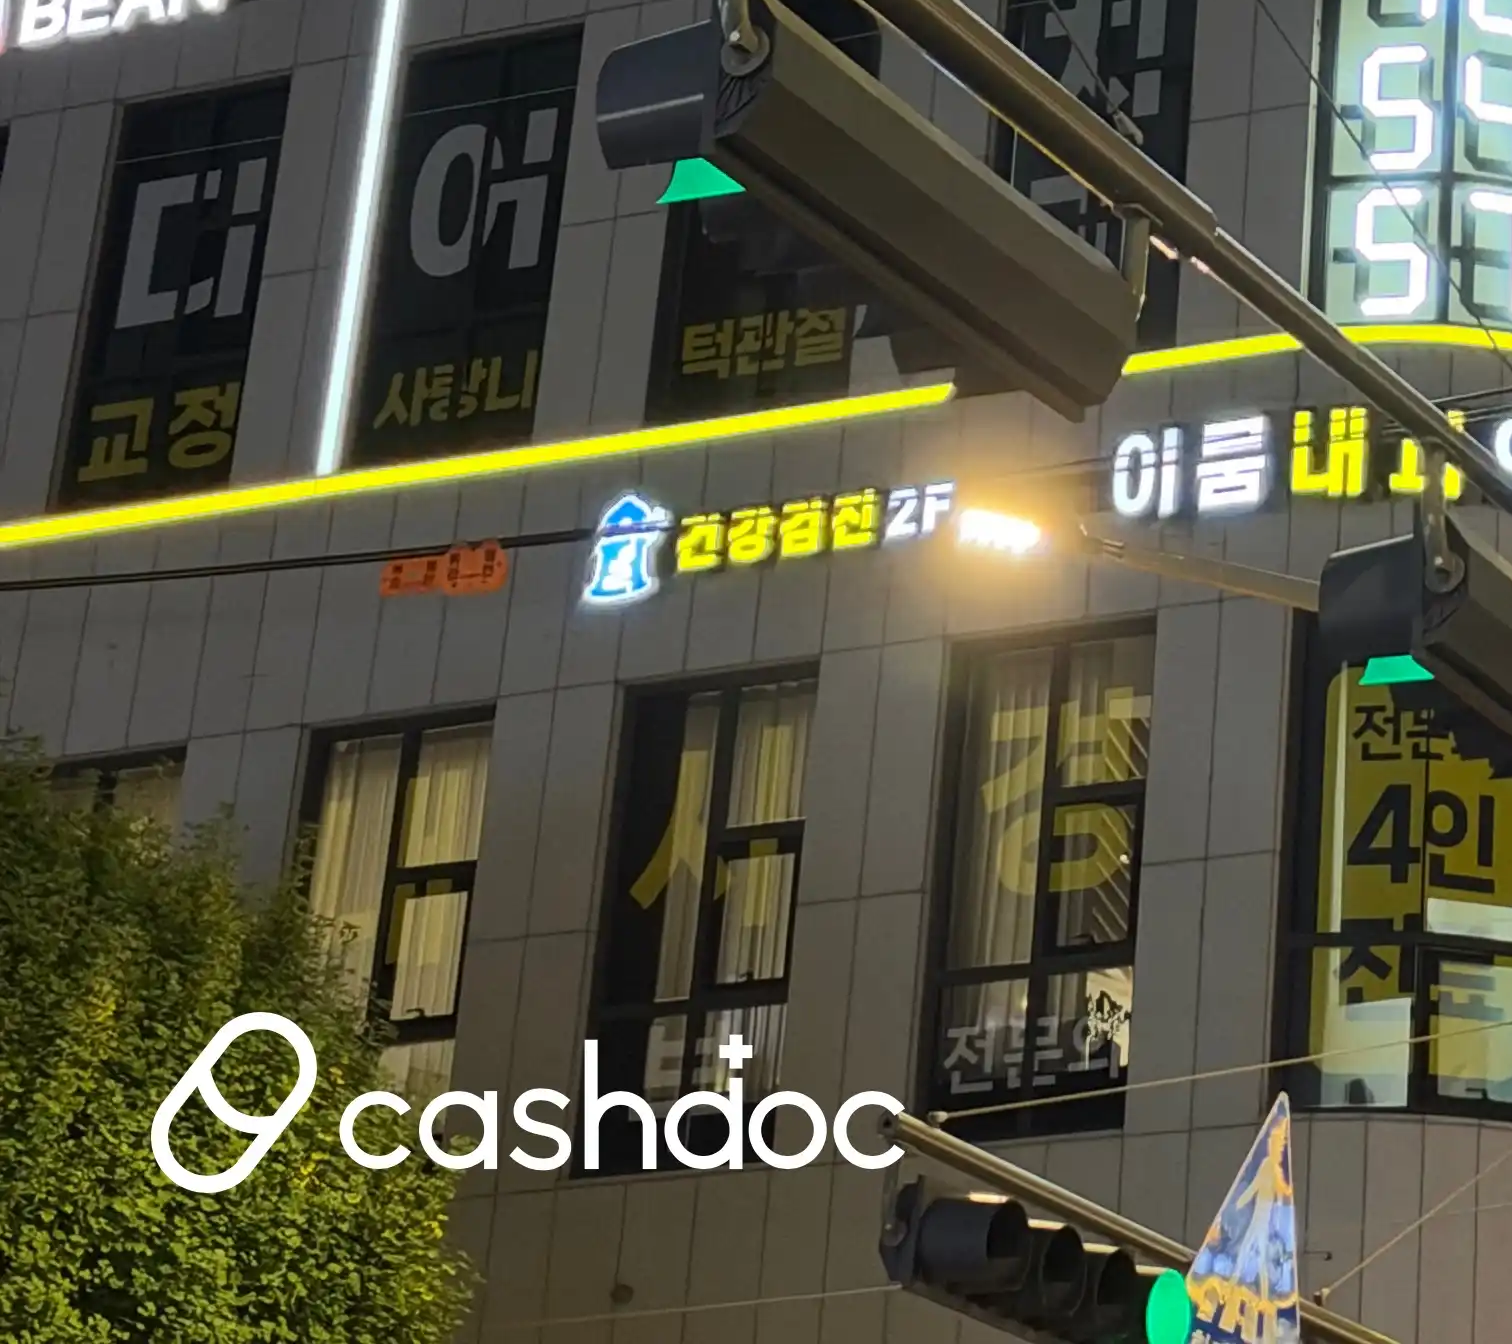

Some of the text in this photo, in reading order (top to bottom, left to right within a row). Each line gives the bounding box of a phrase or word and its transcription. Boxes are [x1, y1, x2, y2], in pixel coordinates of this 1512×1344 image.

[77, 381, 242, 483] 교정
[681, 306, 846, 380] 턱관절
[1346, 783, 1496, 896] 4인
